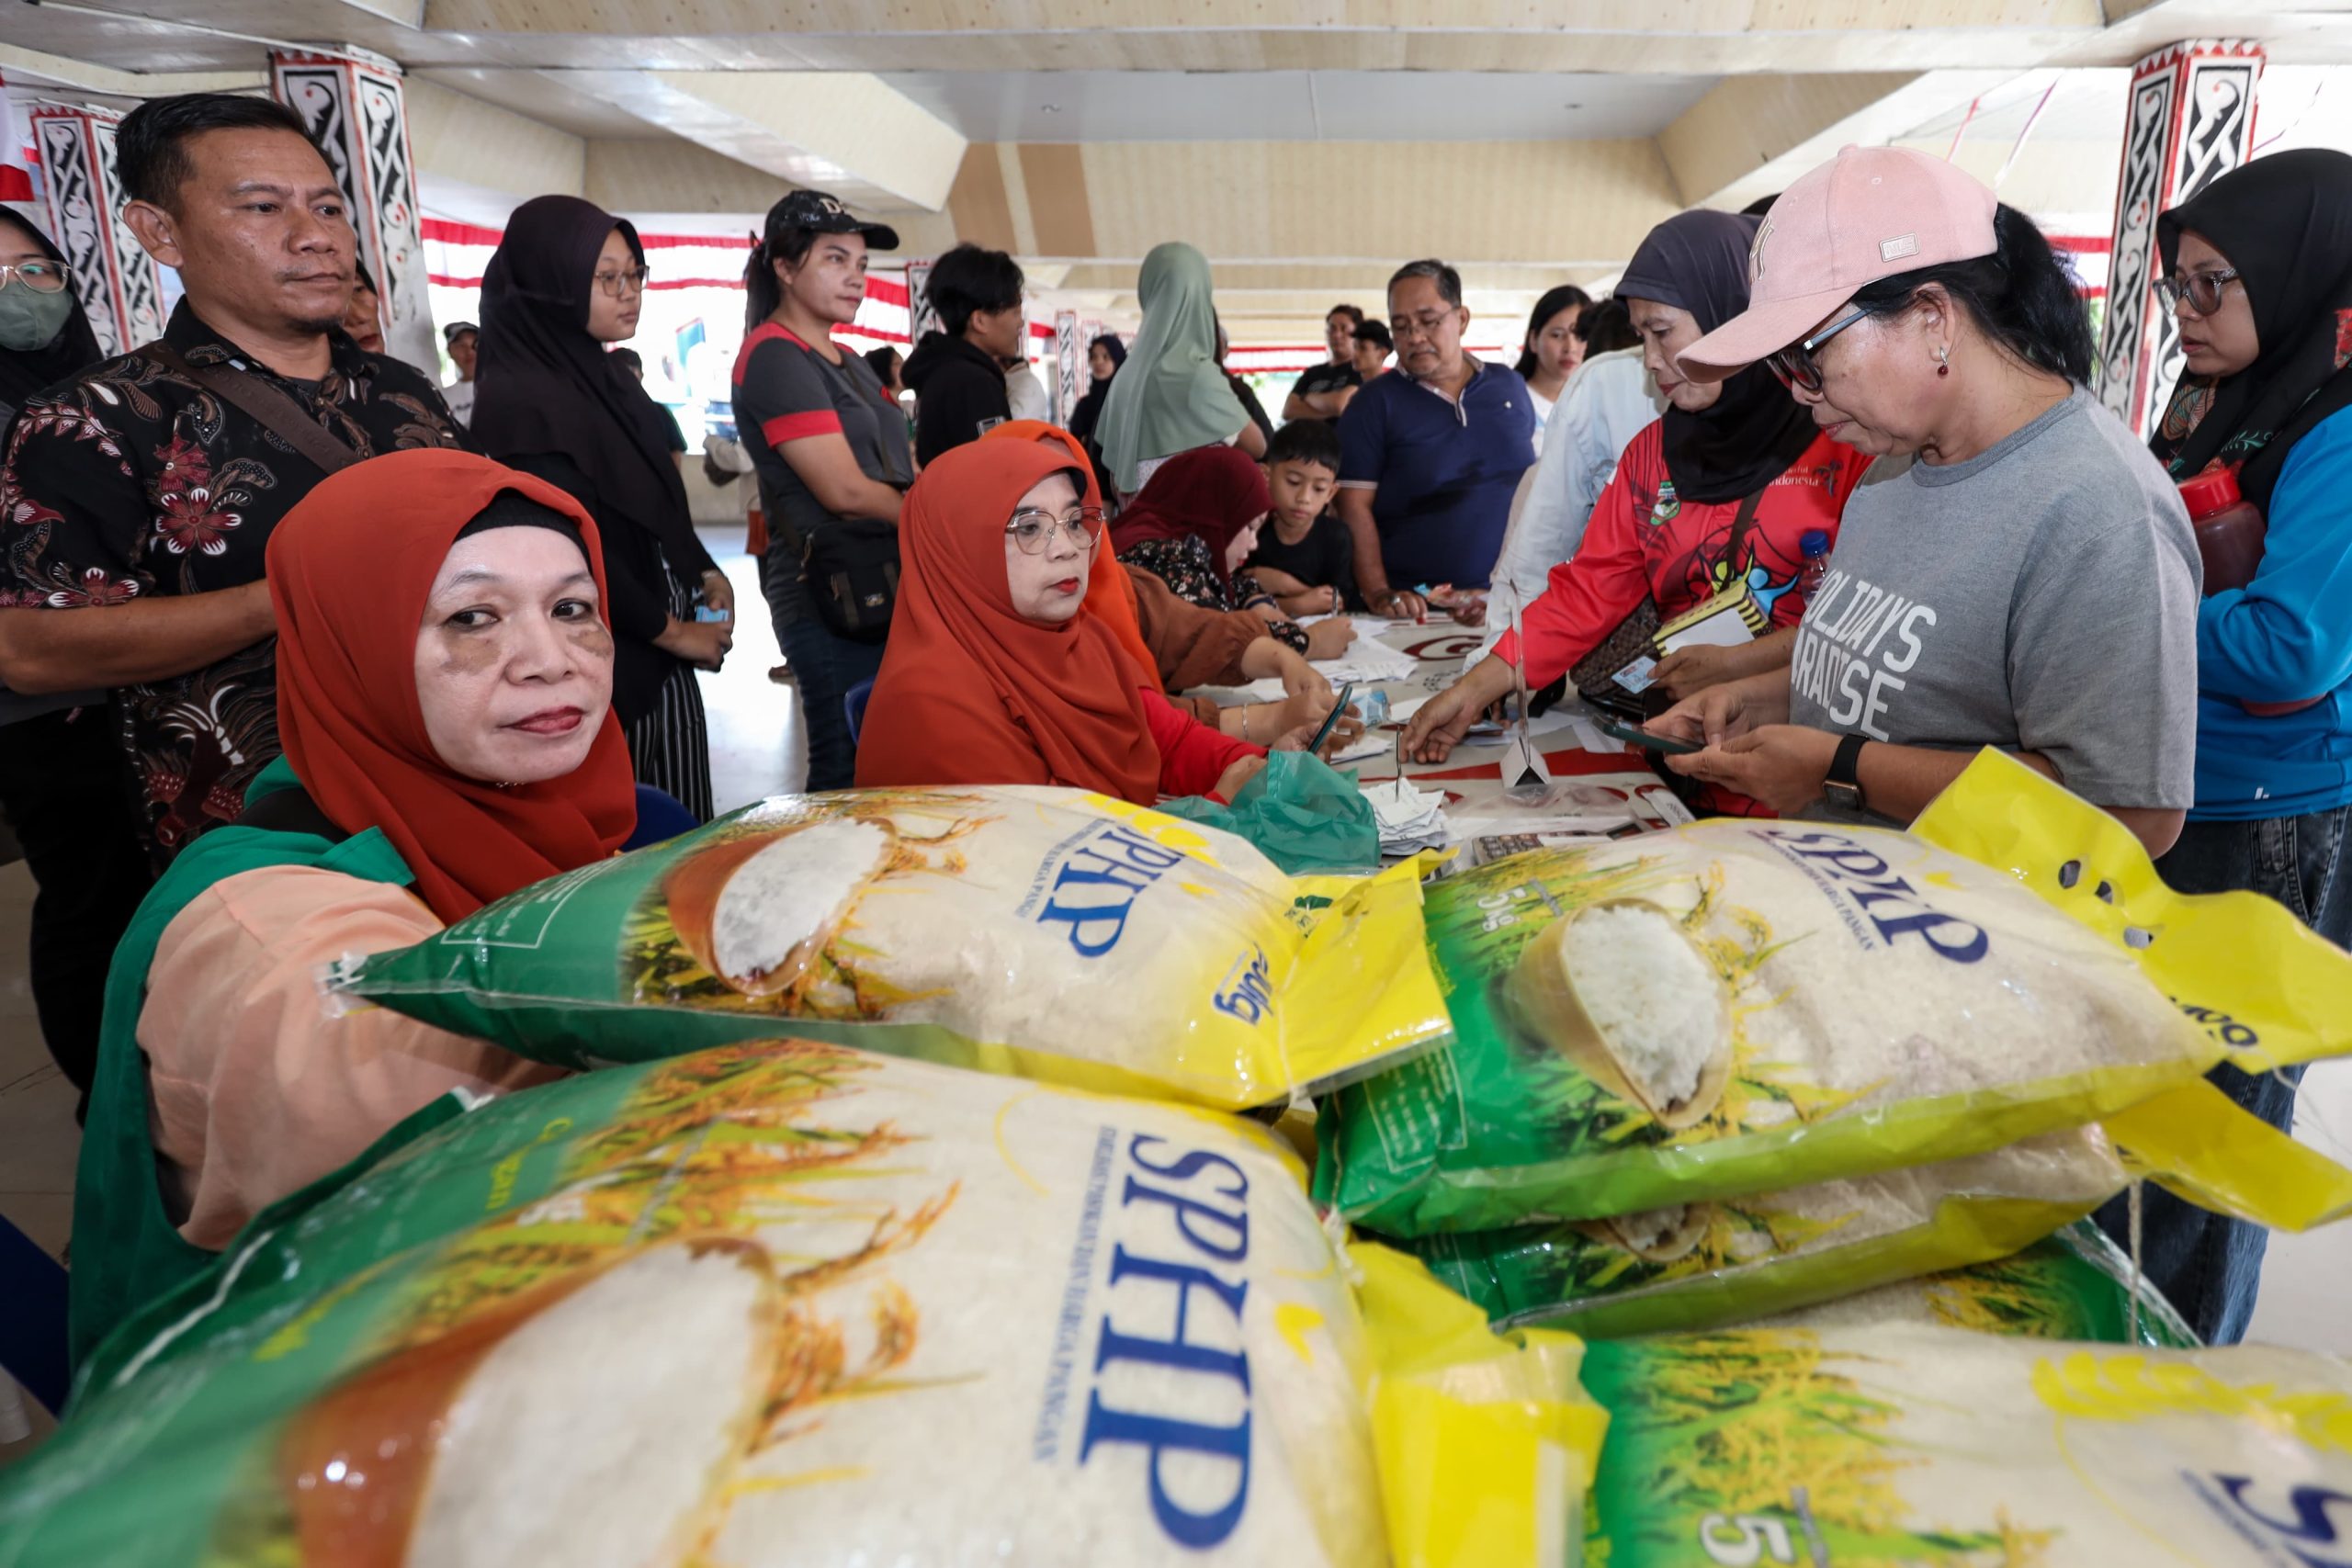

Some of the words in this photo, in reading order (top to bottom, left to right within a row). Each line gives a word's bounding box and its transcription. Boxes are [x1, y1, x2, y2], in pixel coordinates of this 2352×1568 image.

[1768, 474, 1819, 486] ndonesia
[1804, 569, 1937, 673] OLIDAYS
[1792, 627, 1906, 743] ARADISE
[1080, 1133, 1251, 1552] SPHP
